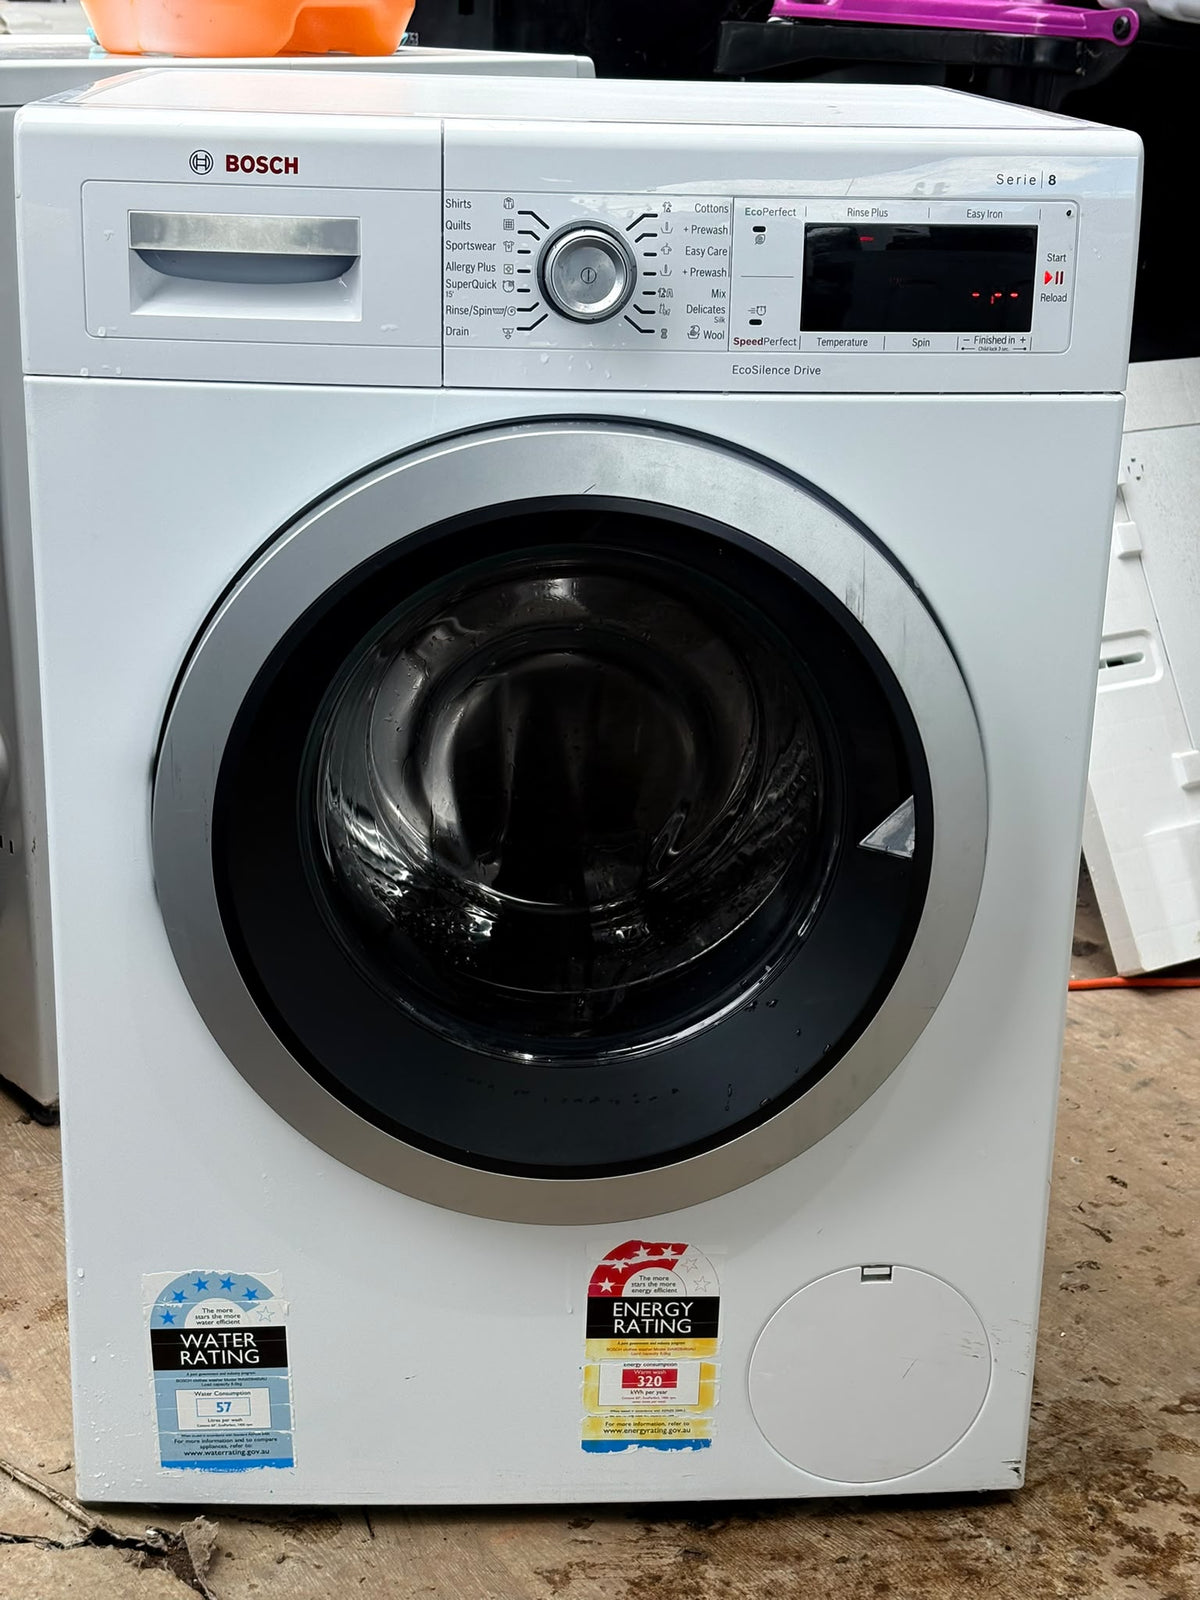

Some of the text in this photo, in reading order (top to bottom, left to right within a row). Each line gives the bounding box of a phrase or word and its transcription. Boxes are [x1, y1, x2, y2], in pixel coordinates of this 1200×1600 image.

[225, 154, 299, 175] BOSCH
[996, 174, 1056, 186] Serie 8
[445, 198, 472, 209] Shirts
[694, 202, 729, 214] Cottons
[744, 207, 796, 217] EcoPerfect
[847, 208, 888, 218] Rinse Plus
[966, 208, 1003, 220] Easy Iron
[445, 220, 472, 230] Quilts
[691, 224, 728, 235] Prewash
[445, 240, 496, 252] Sportswear
[685, 246, 728, 258] Easy Care
[1046, 253, 1067, 262] Start
[445, 262, 496, 274] Allergy Plus
[690, 267, 727, 278] Prewash
[445, 279, 498, 290] SuperQuick
[711, 288, 726, 298] Mix
[1040, 293, 1068, 302] Reload
[445, 304, 492, 318] Rinse/Spin
[686, 304, 726, 314] Delicates
[445, 326, 470, 336] Drain
[703, 330, 725, 340] Wool
[733, 336, 797, 348] SpeedPerfect
[816, 337, 868, 348] Temperature
[912, 338, 930, 348] Spin
[974, 336, 1007, 344] Finished
[1008, 336, 1016, 344] in
[732, 364, 822, 375] EcoSilence Drive
[612, 1302, 694, 1318] ENERGY
[614, 1318, 692, 1334] RATING
[180, 1332, 257, 1348] WATER
[180, 1350, 260, 1366] RATING
[637, 1376, 662, 1387] 320
[216, 1402, 232, 1412] 57
[184, 1448, 270, 1456] www.waterrating.gov.au
